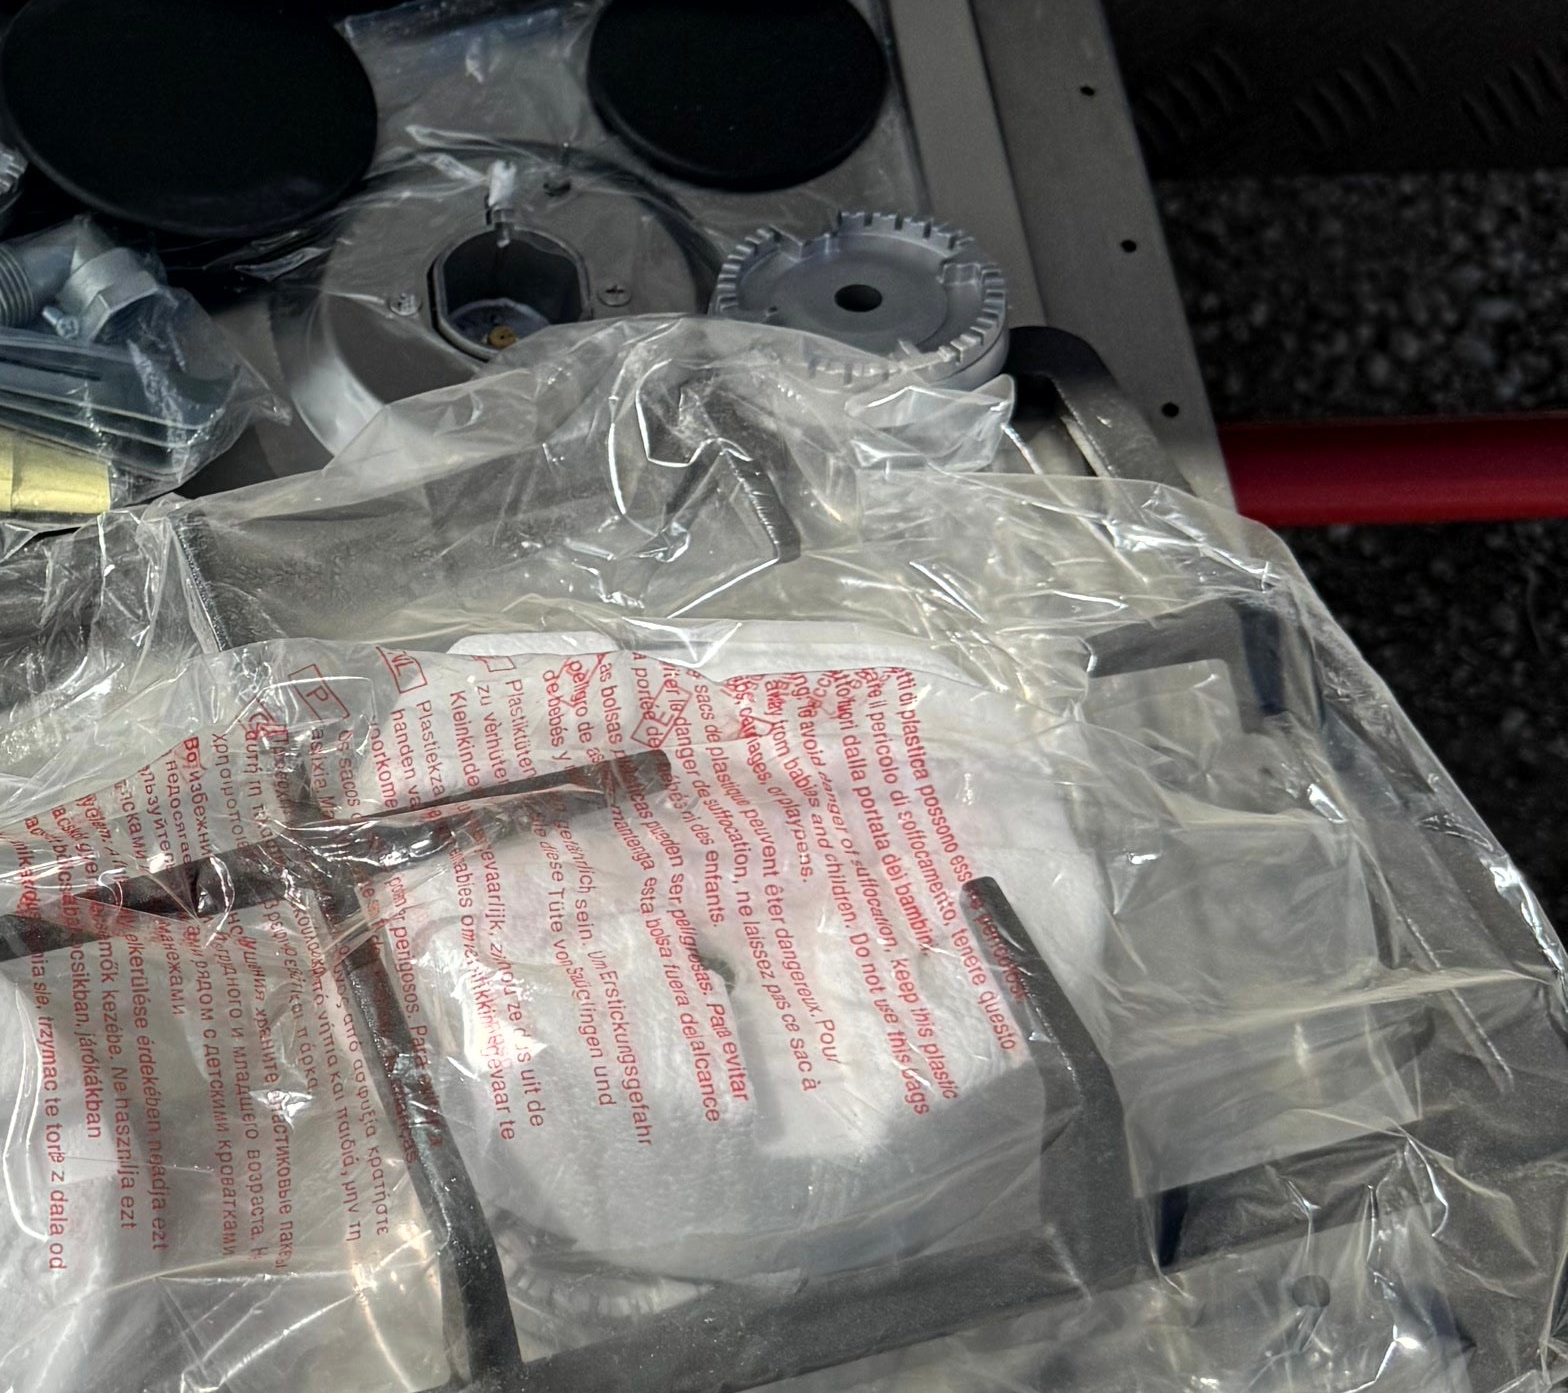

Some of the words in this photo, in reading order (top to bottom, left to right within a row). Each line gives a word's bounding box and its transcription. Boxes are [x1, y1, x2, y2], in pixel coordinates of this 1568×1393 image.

[476, 685, 492, 706] zu
[600, 687, 627, 744] bolsas
[693, 684, 717, 720] sacs
[548, 696, 569, 747] bebés
[577, 721, 594, 743] de
[702, 725, 723, 743] de
[799, 721, 826, 766] avoid
[551, 753, 570, 762] y
[671, 717, 698, 778] danger
[865, 712, 899, 784] pericolo
[631, 668, 655, 720] portée
[687, 824, 715, 845] des
[703, 850, 724, 927] enfants.
[691, 780, 712, 798] de
[708, 746, 751, 806] plastique
[780, 758, 821, 807] babies
[889, 791, 912, 806] di
[897, 710, 931, 780] plastica
[918, 785, 960, 853] possono
[818, 771, 848, 833] danger
[841, 735, 869, 781] dalla
[855, 786, 889, 850] portata
[881, 855, 907, 882] dei
[645, 820, 687, 868] pueden
[704, 799, 749, 885] suffocation,
[741, 809, 780, 877] peuvent
[770, 796, 813, 882] playpens.
[811, 813, 833, 848] and
[539, 841, 565, 882] diese
[896, 810, 958, 927] soffocamento,
[338, 757, 360, 806] sacos
[389, 927, 421, 1019] perigosos.
[548, 888, 565, 933] Tüte
[639, 877, 658, 914] esta
[669, 873, 687, 904] ser
[734, 890, 753, 918] ne
[824, 853, 856, 929] children.
[851, 859, 900, 953] suffocation,
[390, 708, 418, 780] handen
[498, 1119, 516, 1141] te
[645, 918, 677, 958] bolsa
[849, 932, 871, 957] Do
[553, 939, 574, 966] von
[666, 909, 715, 996] peligrosas.
[741, 921, 778, 979] laissez
[773, 928, 824, 1017] dangereux.
[952, 930, 986, 986] tenere
[123, 933, 150, 1029] elkerülése
[192, 959, 215, 1020] рядом
[662, 964, 689, 1006] fuera
[765, 984, 793, 1010] pas
[859, 963, 886, 994] not
[889, 959, 920, 1004] keep
[102, 989, 122, 1060] kezébe.
[203, 1028, 216, 1039] с
[232, 1027, 245, 1038] и
[506, 1002, 522, 1022] ze
[574, 899, 594, 947] sein.
[598, 970, 654, 1147] Erstickungsgefahr
[680, 1012, 704, 1039] del
[780, 1013, 800, 1032] ce
[874, 999, 901, 1023] use
[910, 1008, 936, 1038] this
[978, 991, 1018, 1051] questo
[37, 1016, 60, 1091] trzymac
[789, 1037, 815, 1072] sac
[814, 1019, 842, 1064] Pour
[887, 1030, 912, 1063] this
[74, 1031, 103, 1139] járókákban
[110, 1066, 129, 1093] Ne
[136, 1035, 163, 1133] érdekében
[204, 1044, 231, 1133] детскими
[233, 1046, 259, 1139] младшего
[329, 1071, 346, 1102] και
[520, 1068, 541, 1094] uit
[594, 1066, 616, 1106] und
[690, 1040, 721, 1122] alcance
[721, 1042, 750, 1101] evitar
[801, 1077, 822, 1091] à
[900, 1069, 931, 1114] bags
[922, 1043, 960, 1100] plastic
[46, 1098, 62, 1117] te
[526, 1100, 546, 1127] de
[51, 1170, 66, 1183] z
[214, 1140, 236, 1256] кроватками
[246, 1149, 266, 1241] возраста.
[340, 1180, 361, 1214] μην
[366, 1147, 390, 1236] κρατήστε
[49, 1189, 68, 1236] dala
[120, 1196, 137, 1230] ezt
[151, 1217, 170, 1251] ezt
[346, 1220, 362, 1242] τη
[49, 1242, 67, 1270] od
